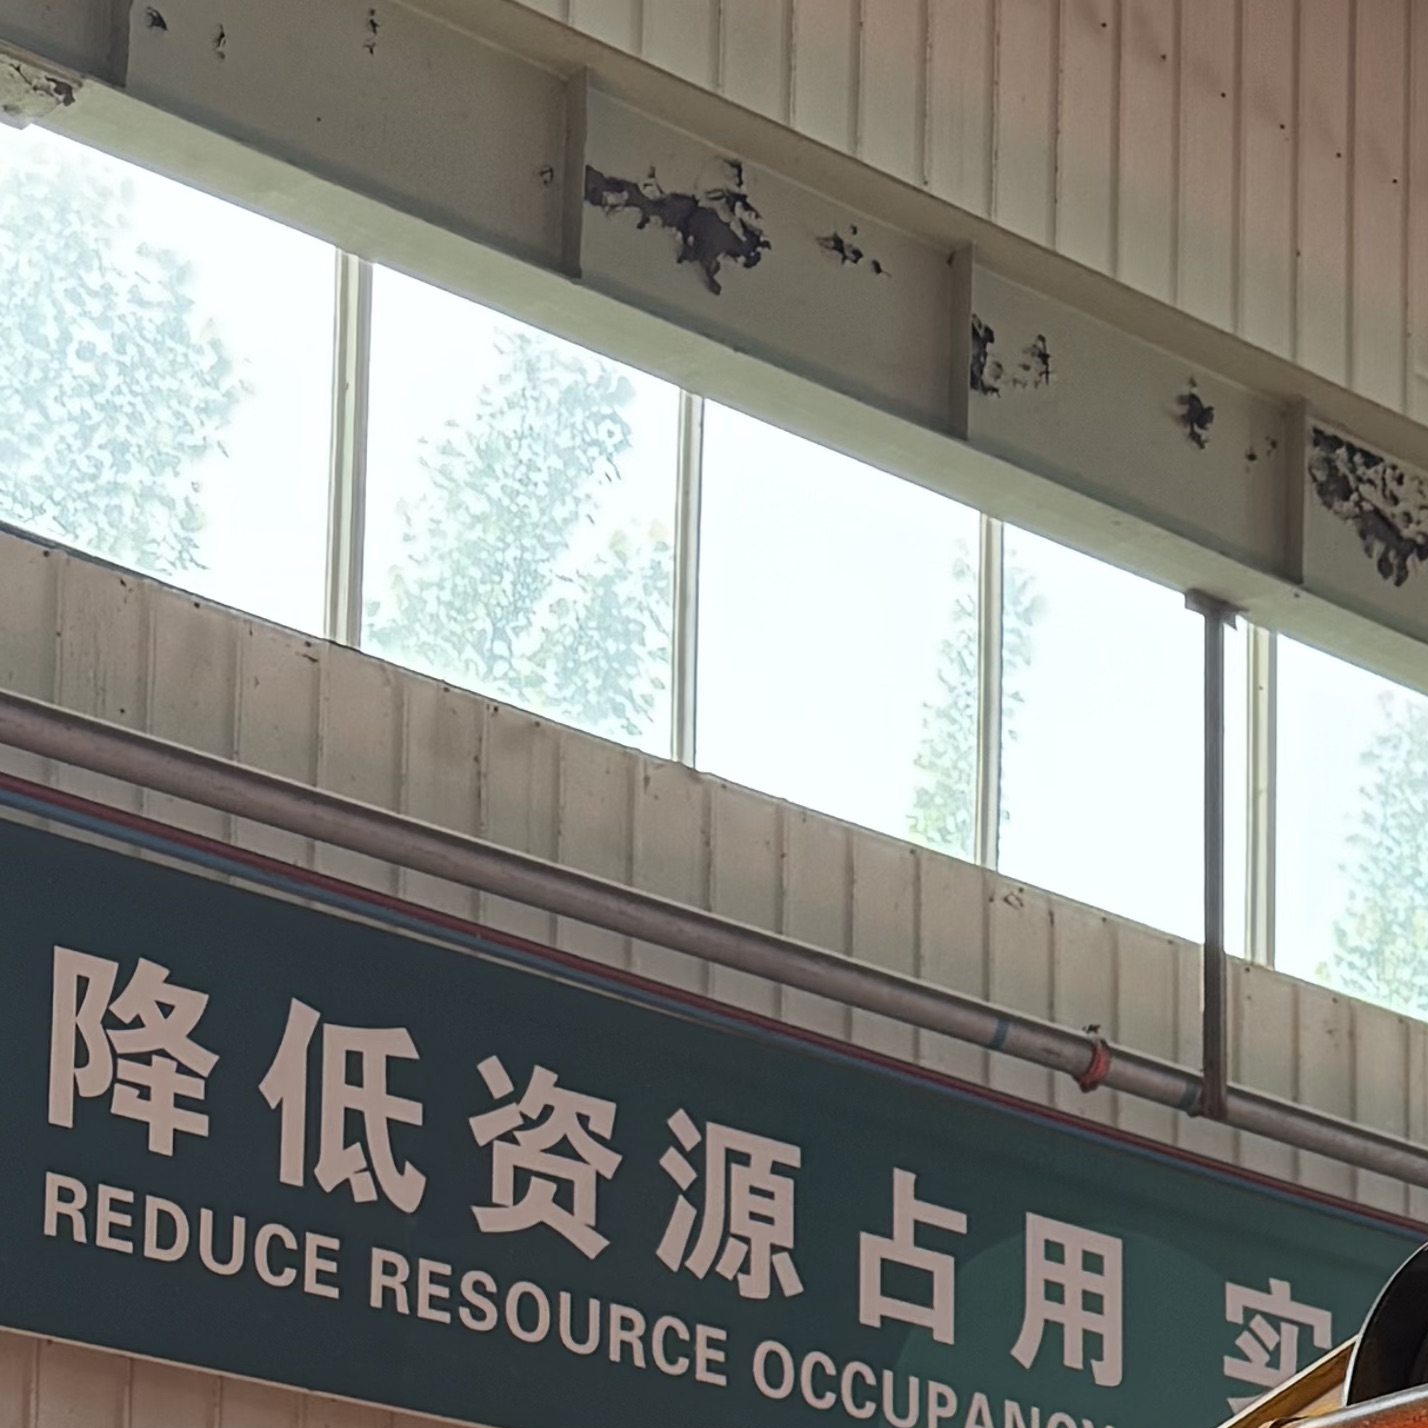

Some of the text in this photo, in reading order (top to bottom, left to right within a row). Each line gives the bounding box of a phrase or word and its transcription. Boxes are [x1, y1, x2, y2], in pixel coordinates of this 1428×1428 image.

[43, 1171, 341, 1299] REDUCE
[369, 1247, 728, 1387] RESOURCE
[48, 945, 1124, 1388] 降低资源占用
